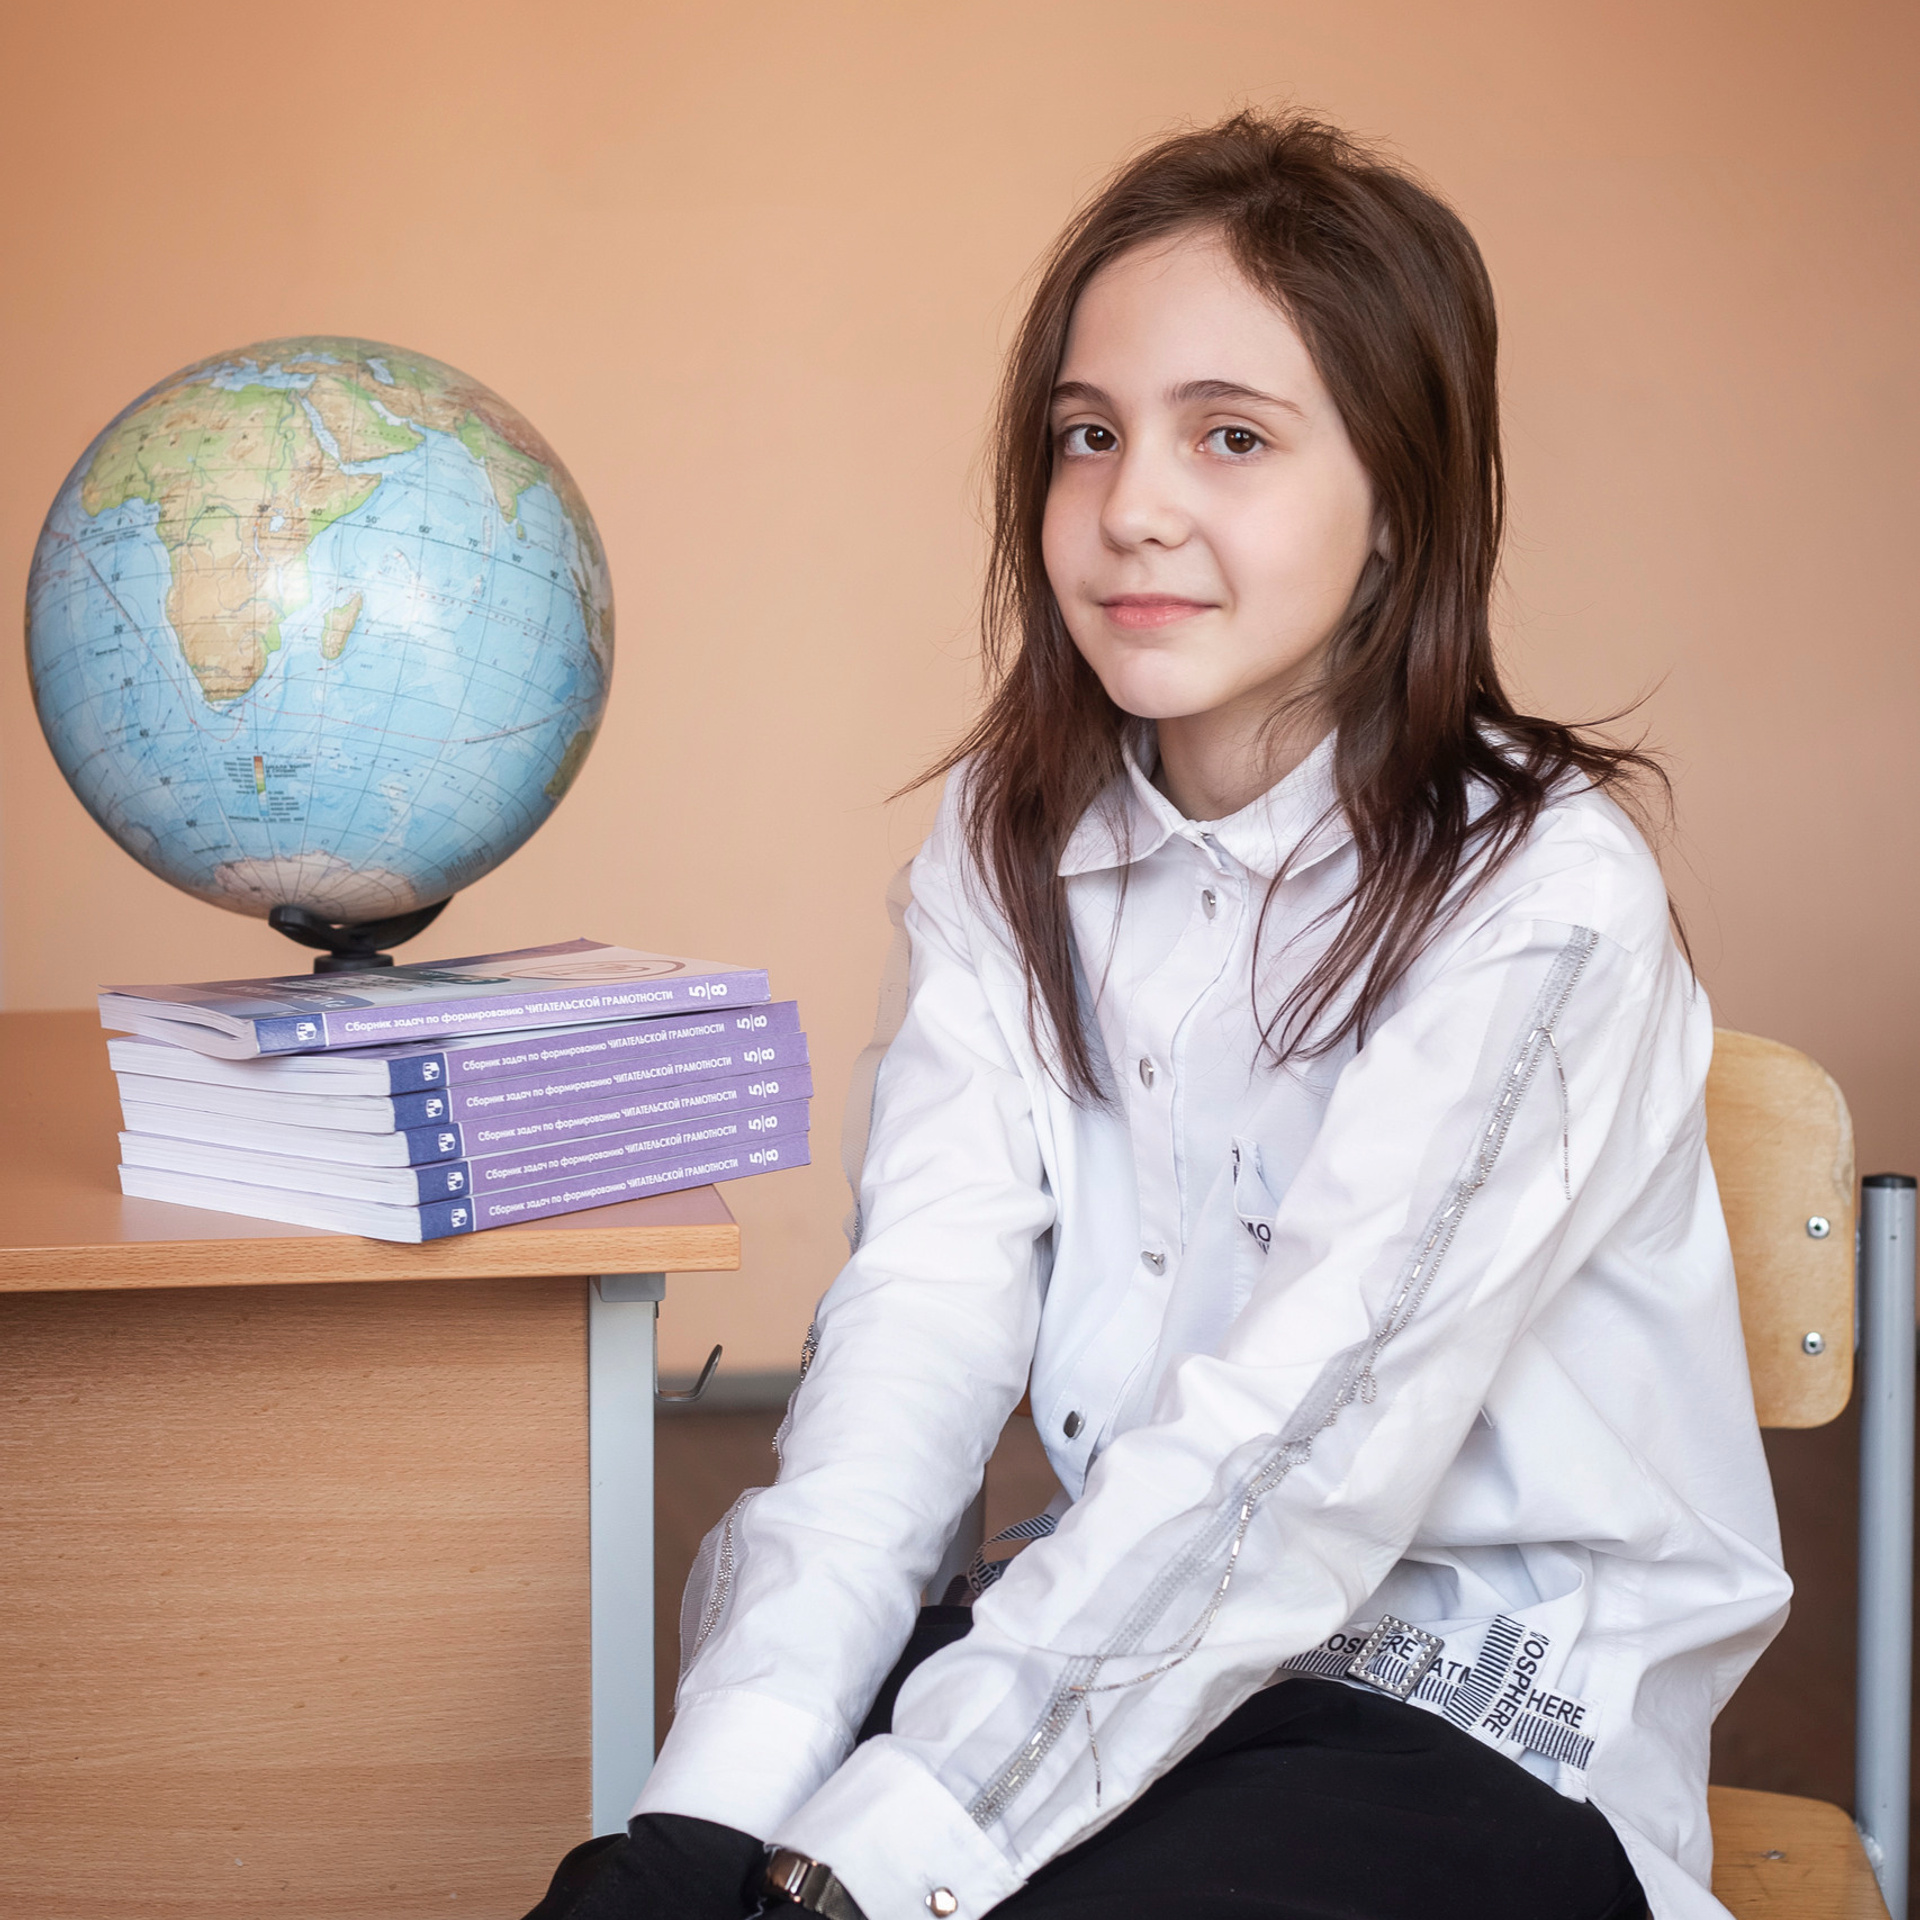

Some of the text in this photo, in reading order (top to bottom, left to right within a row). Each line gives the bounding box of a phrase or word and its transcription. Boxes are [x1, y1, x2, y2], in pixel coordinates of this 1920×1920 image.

[345, 991, 673, 1033] Сборник задач по формированию ЧИТАТЕЛЬСКОЙ ГРАМОТНОСТИ
[462, 1024, 724, 1071] Сборник задач по формированию ЧИТАТЕЛЬСКОЙ ГРАМОТНОСТИ
[466, 1057, 732, 1108] Сборник задач по формированию ЧИТАТЕЛЬСКОЙ ГРАМОТНОСТИ
[478, 1091, 737, 1142] Сборник задач по формированию ЧИТАТЕЛЬСКОЙ ГРАМОТНОСТИ
[485, 1125, 736, 1180] Сборник задач по формированию ЧИТАТЕЛЬСКОЙ ГРАМОТНОСТИ
[489, 1159, 738, 1216] Сборник задач по формированию ЧИТАТЕЛЬСКОЙ ГРАМОТНОСТИ
[1525, 1689, 1586, 1729] HERE
